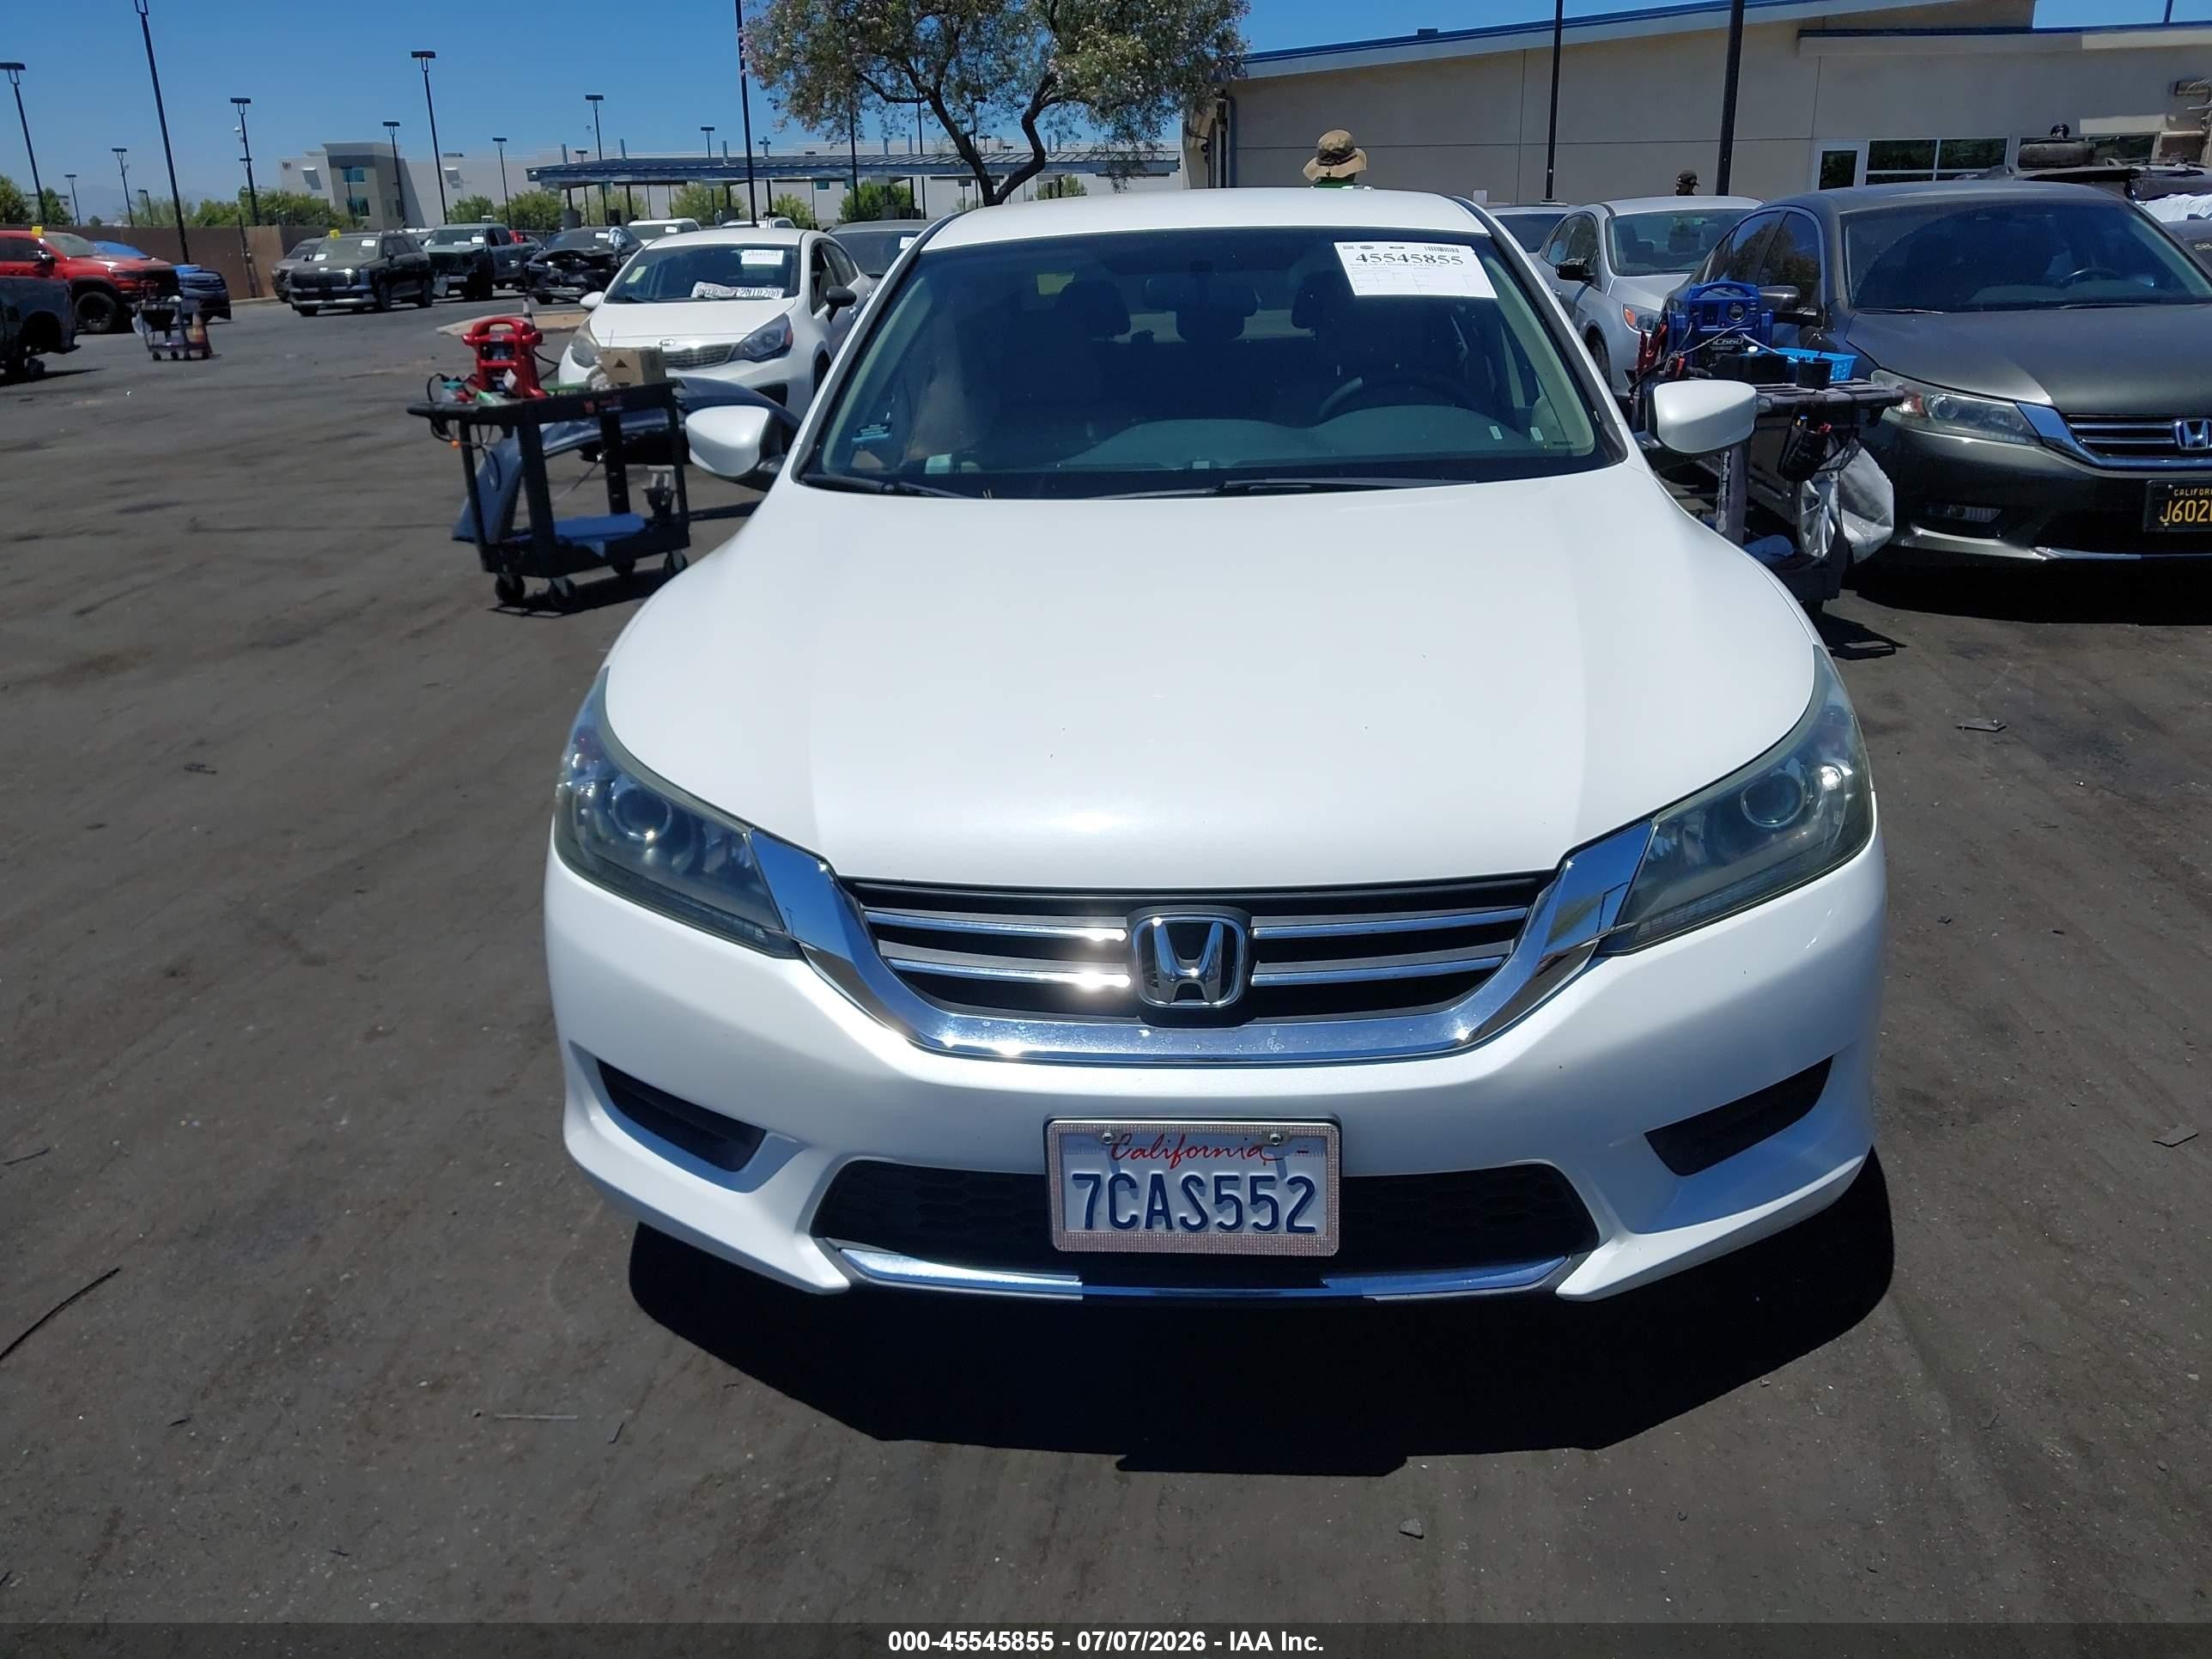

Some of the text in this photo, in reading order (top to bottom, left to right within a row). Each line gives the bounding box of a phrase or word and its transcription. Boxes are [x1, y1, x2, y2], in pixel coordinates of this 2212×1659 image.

[1355, 252, 1464, 265] 45545855
[2173, 488, 2212, 496] CALIFOR
[2159, 499, 2212, 523] J602
[1110, 1133, 1284, 1170] California
[1072, 1173, 1316, 1233] 7CAS552
